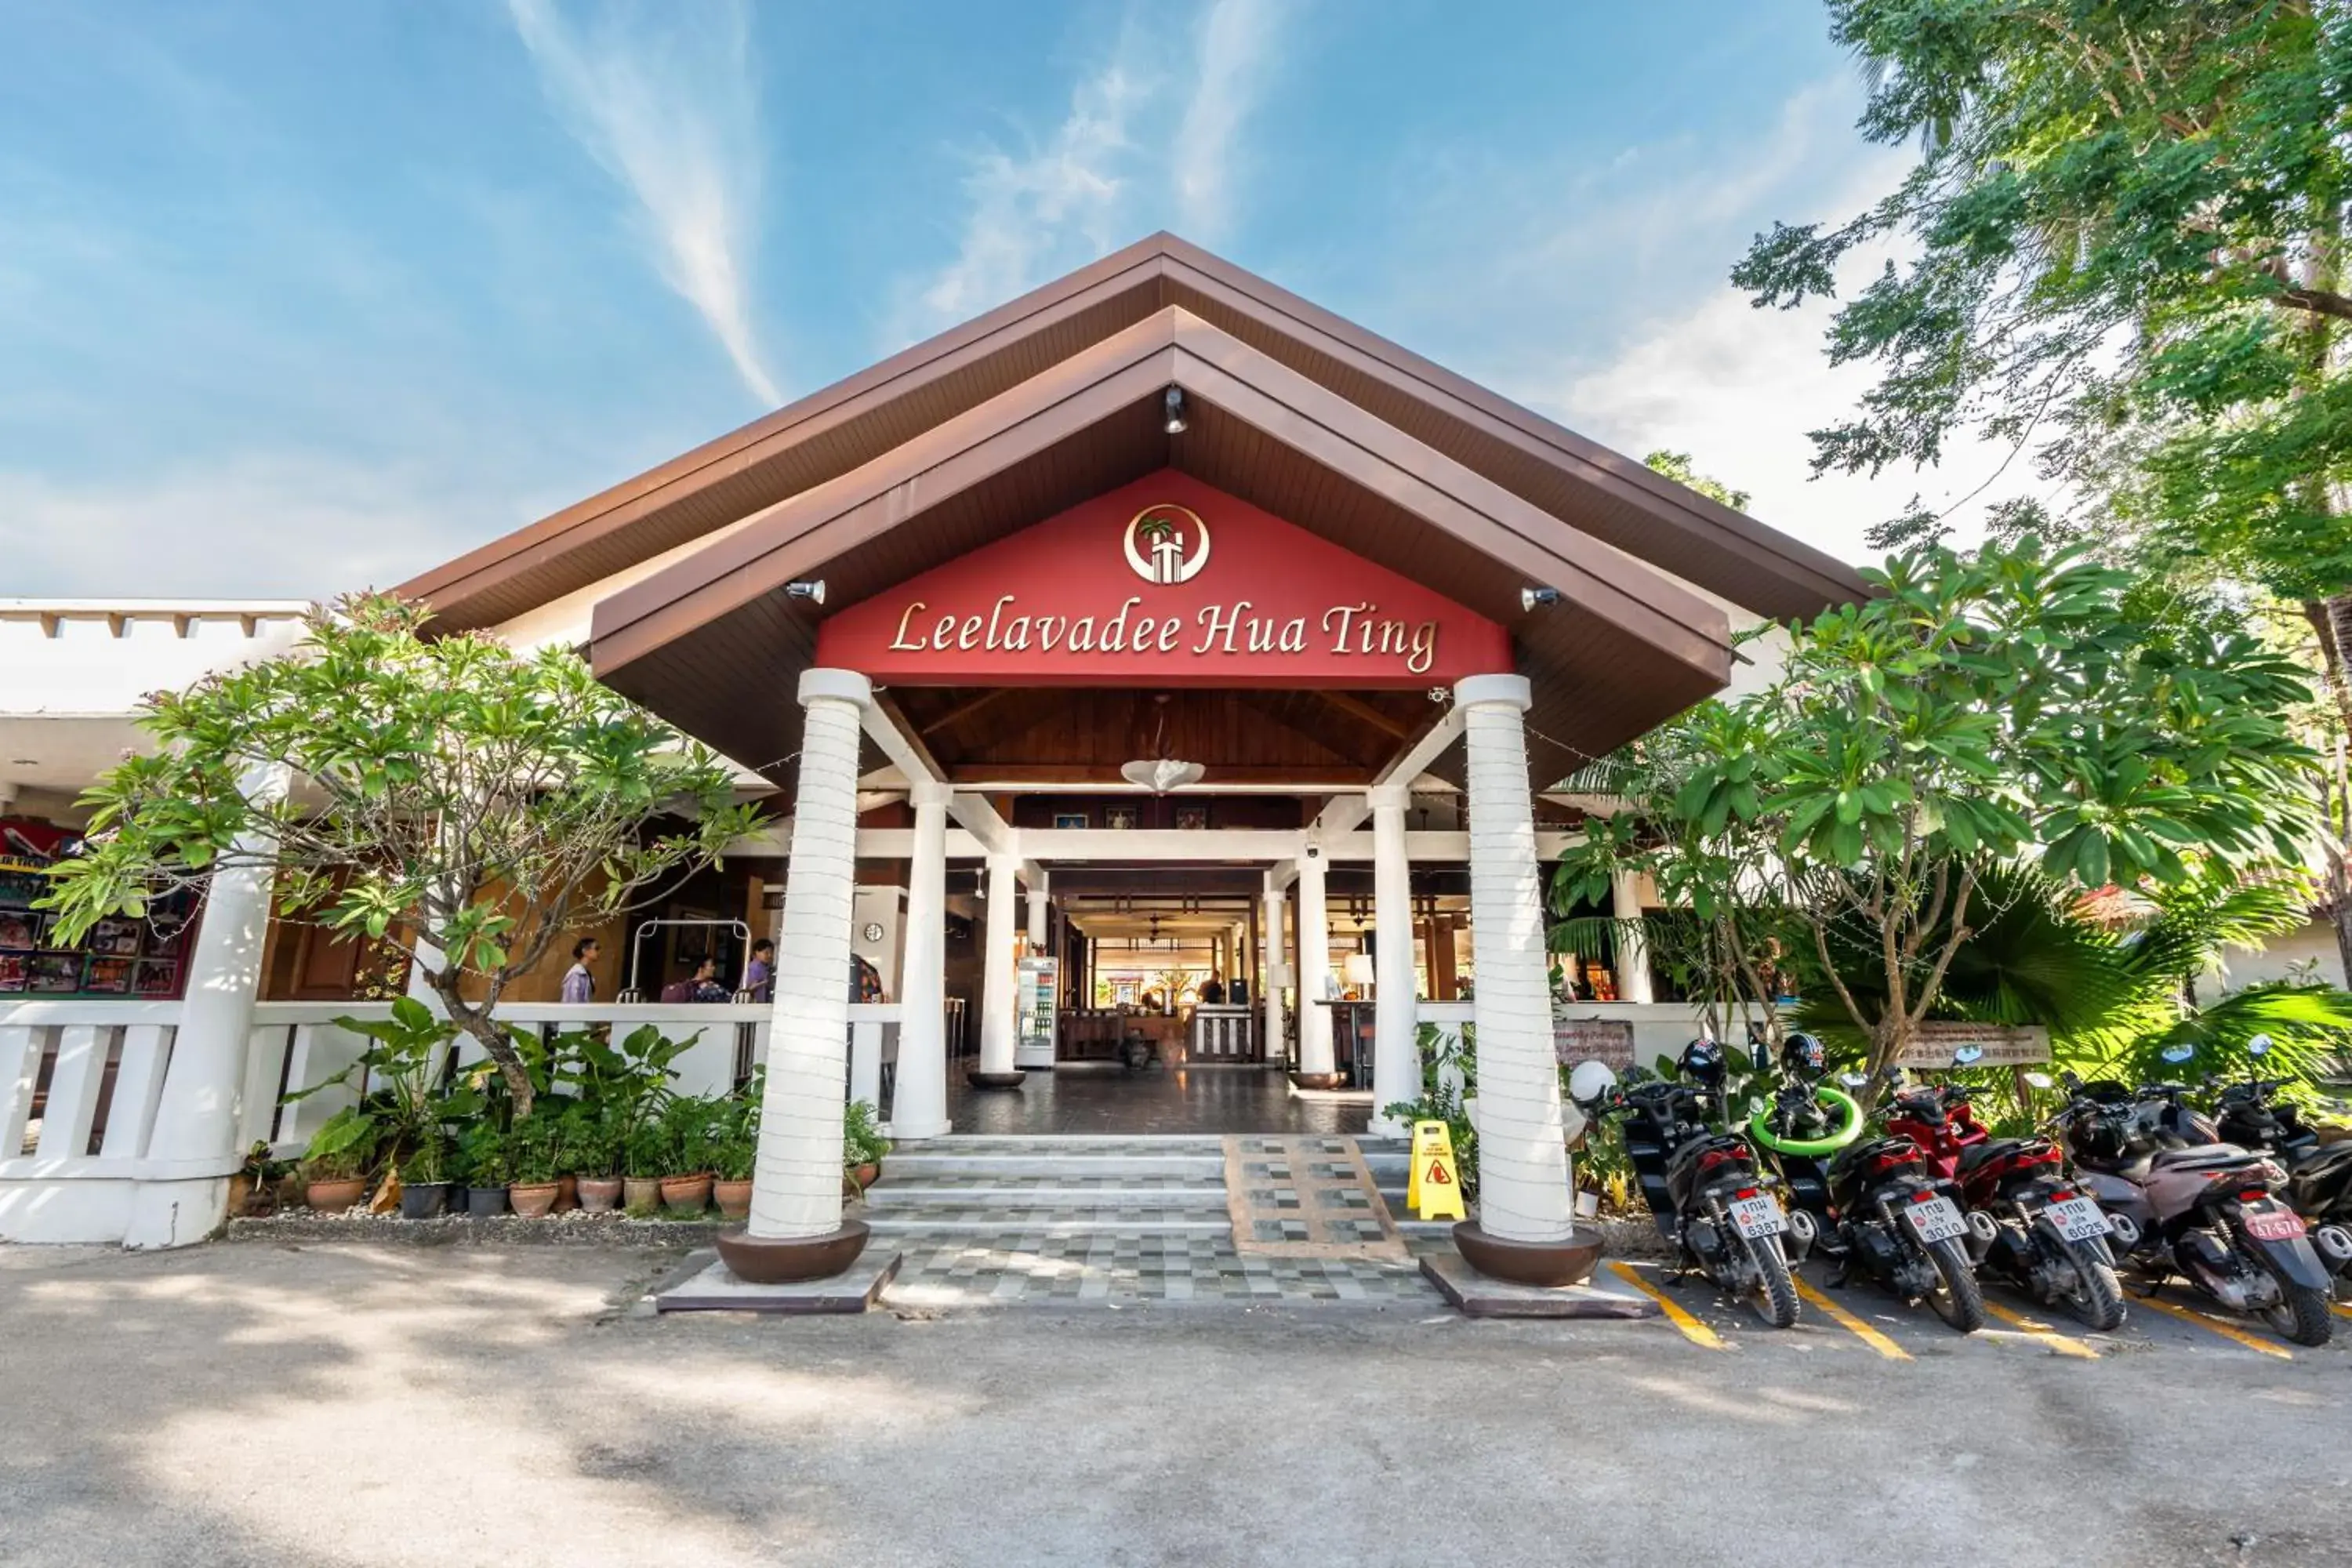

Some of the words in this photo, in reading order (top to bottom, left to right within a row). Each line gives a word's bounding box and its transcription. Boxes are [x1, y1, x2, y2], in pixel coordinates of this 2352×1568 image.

[888, 594, 1181, 653] Leelavadee
[1192, 601, 1308, 654] Hua
[1323, 601, 1439, 673] Ting
[1747, 1220, 1779, 1236] 6387
